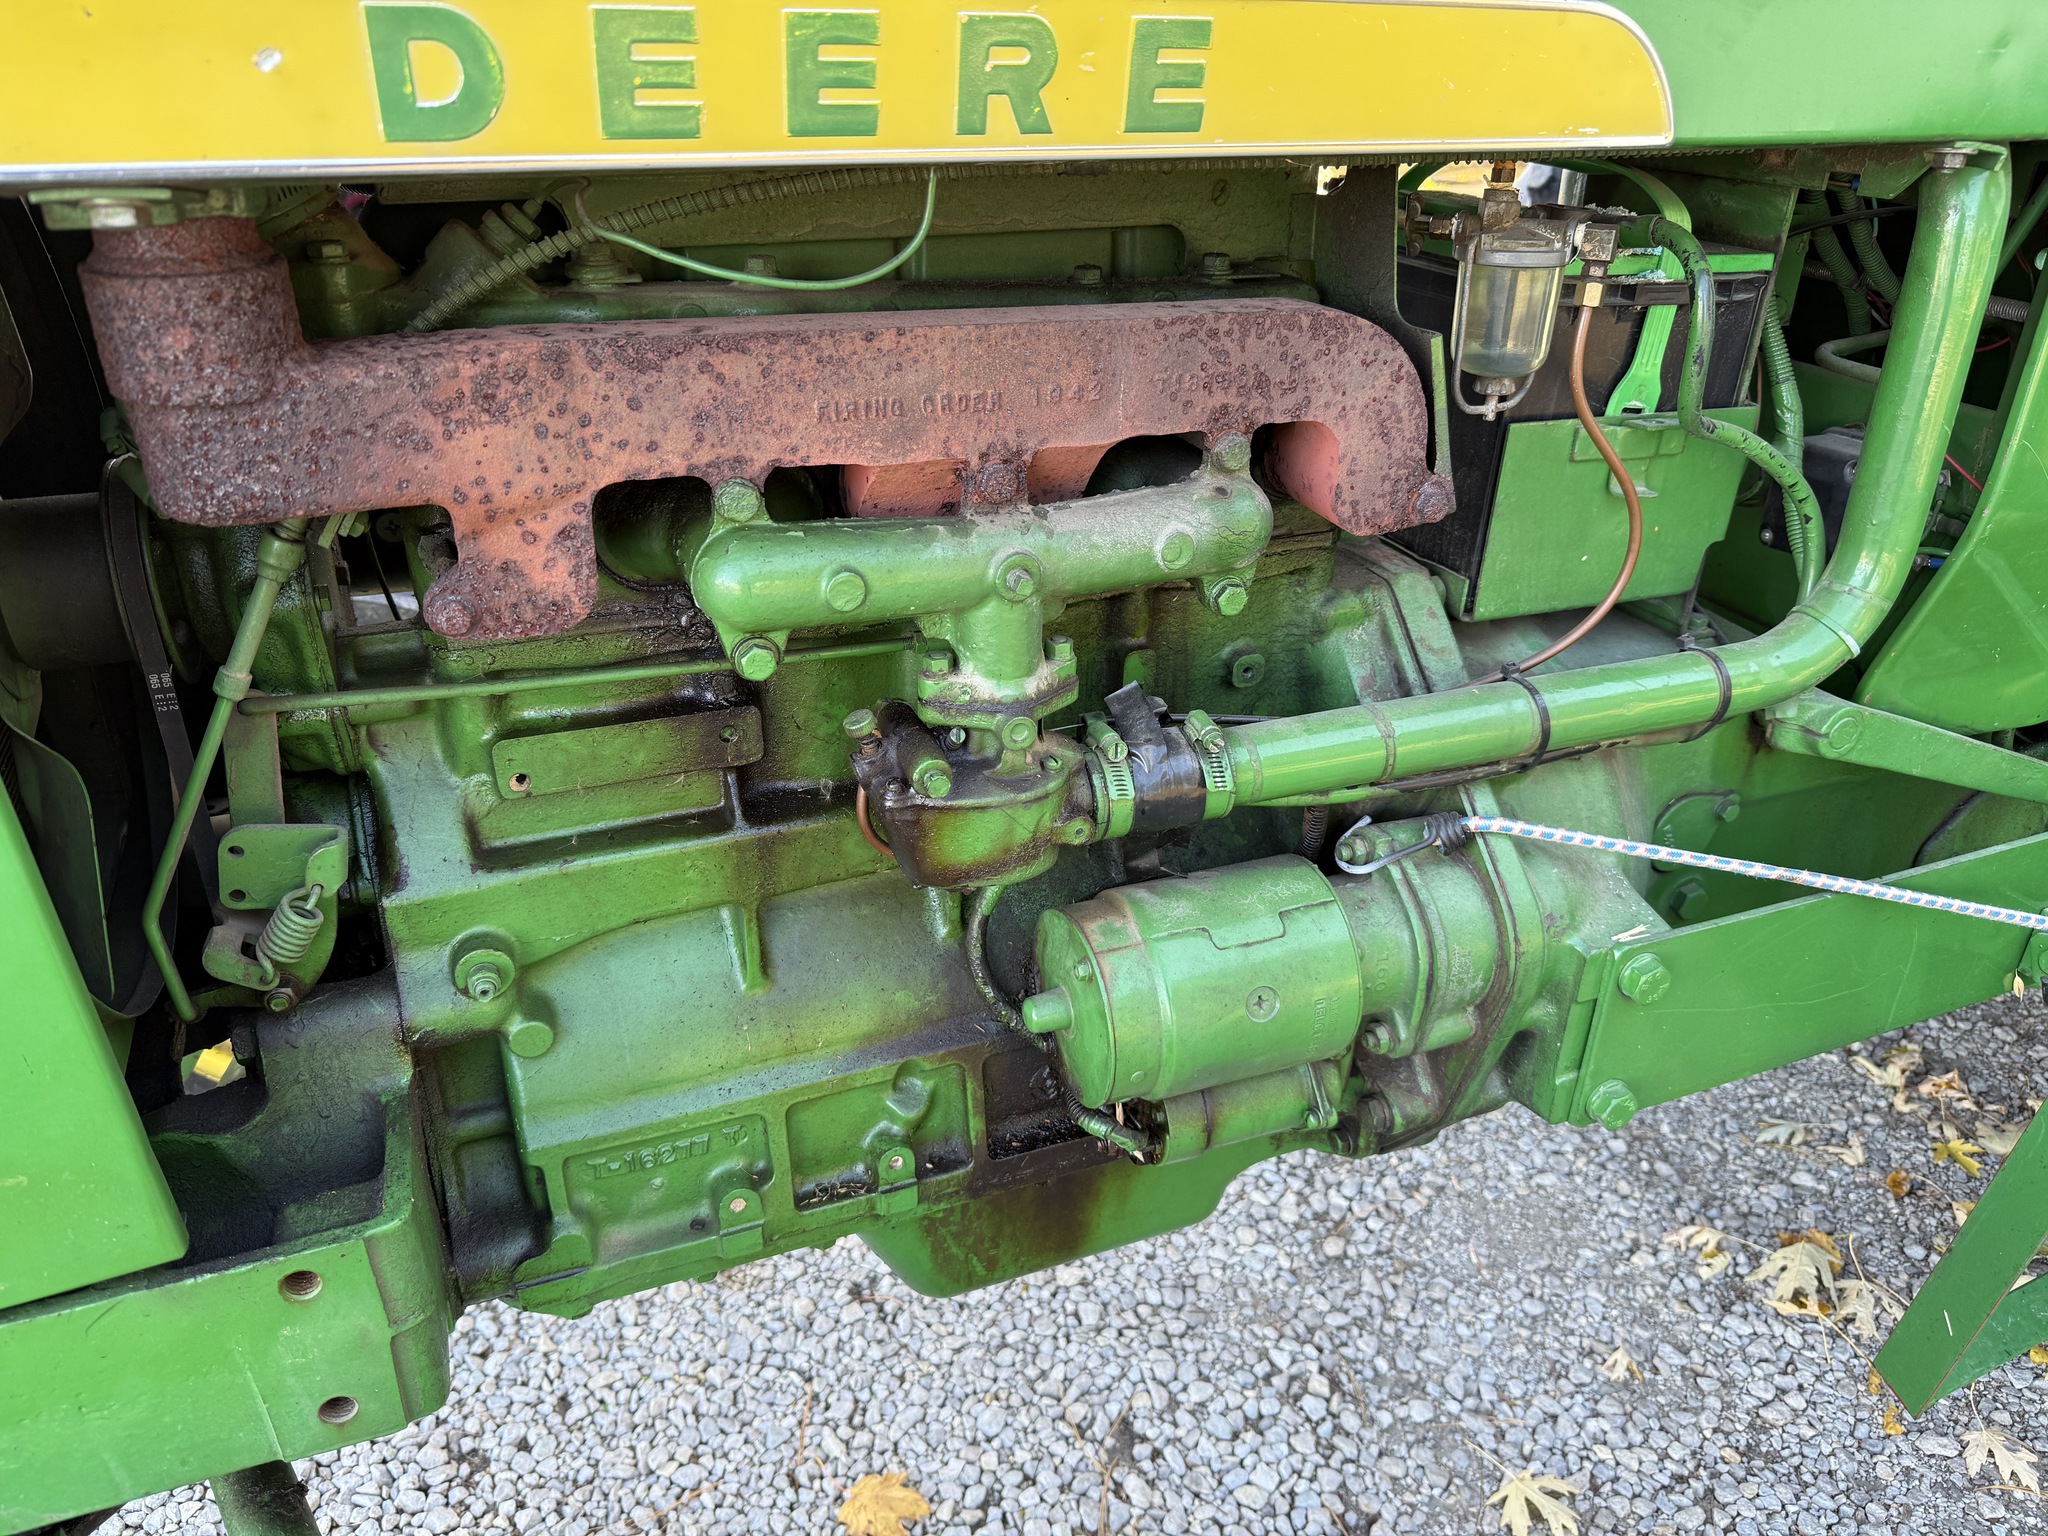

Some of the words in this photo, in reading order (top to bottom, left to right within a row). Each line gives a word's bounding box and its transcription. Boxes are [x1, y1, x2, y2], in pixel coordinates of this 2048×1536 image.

[364, 1, 1213, 142] DEERE
[815, 397, 904, 423] FIRING
[921, 389, 1002, 416] ORDER
